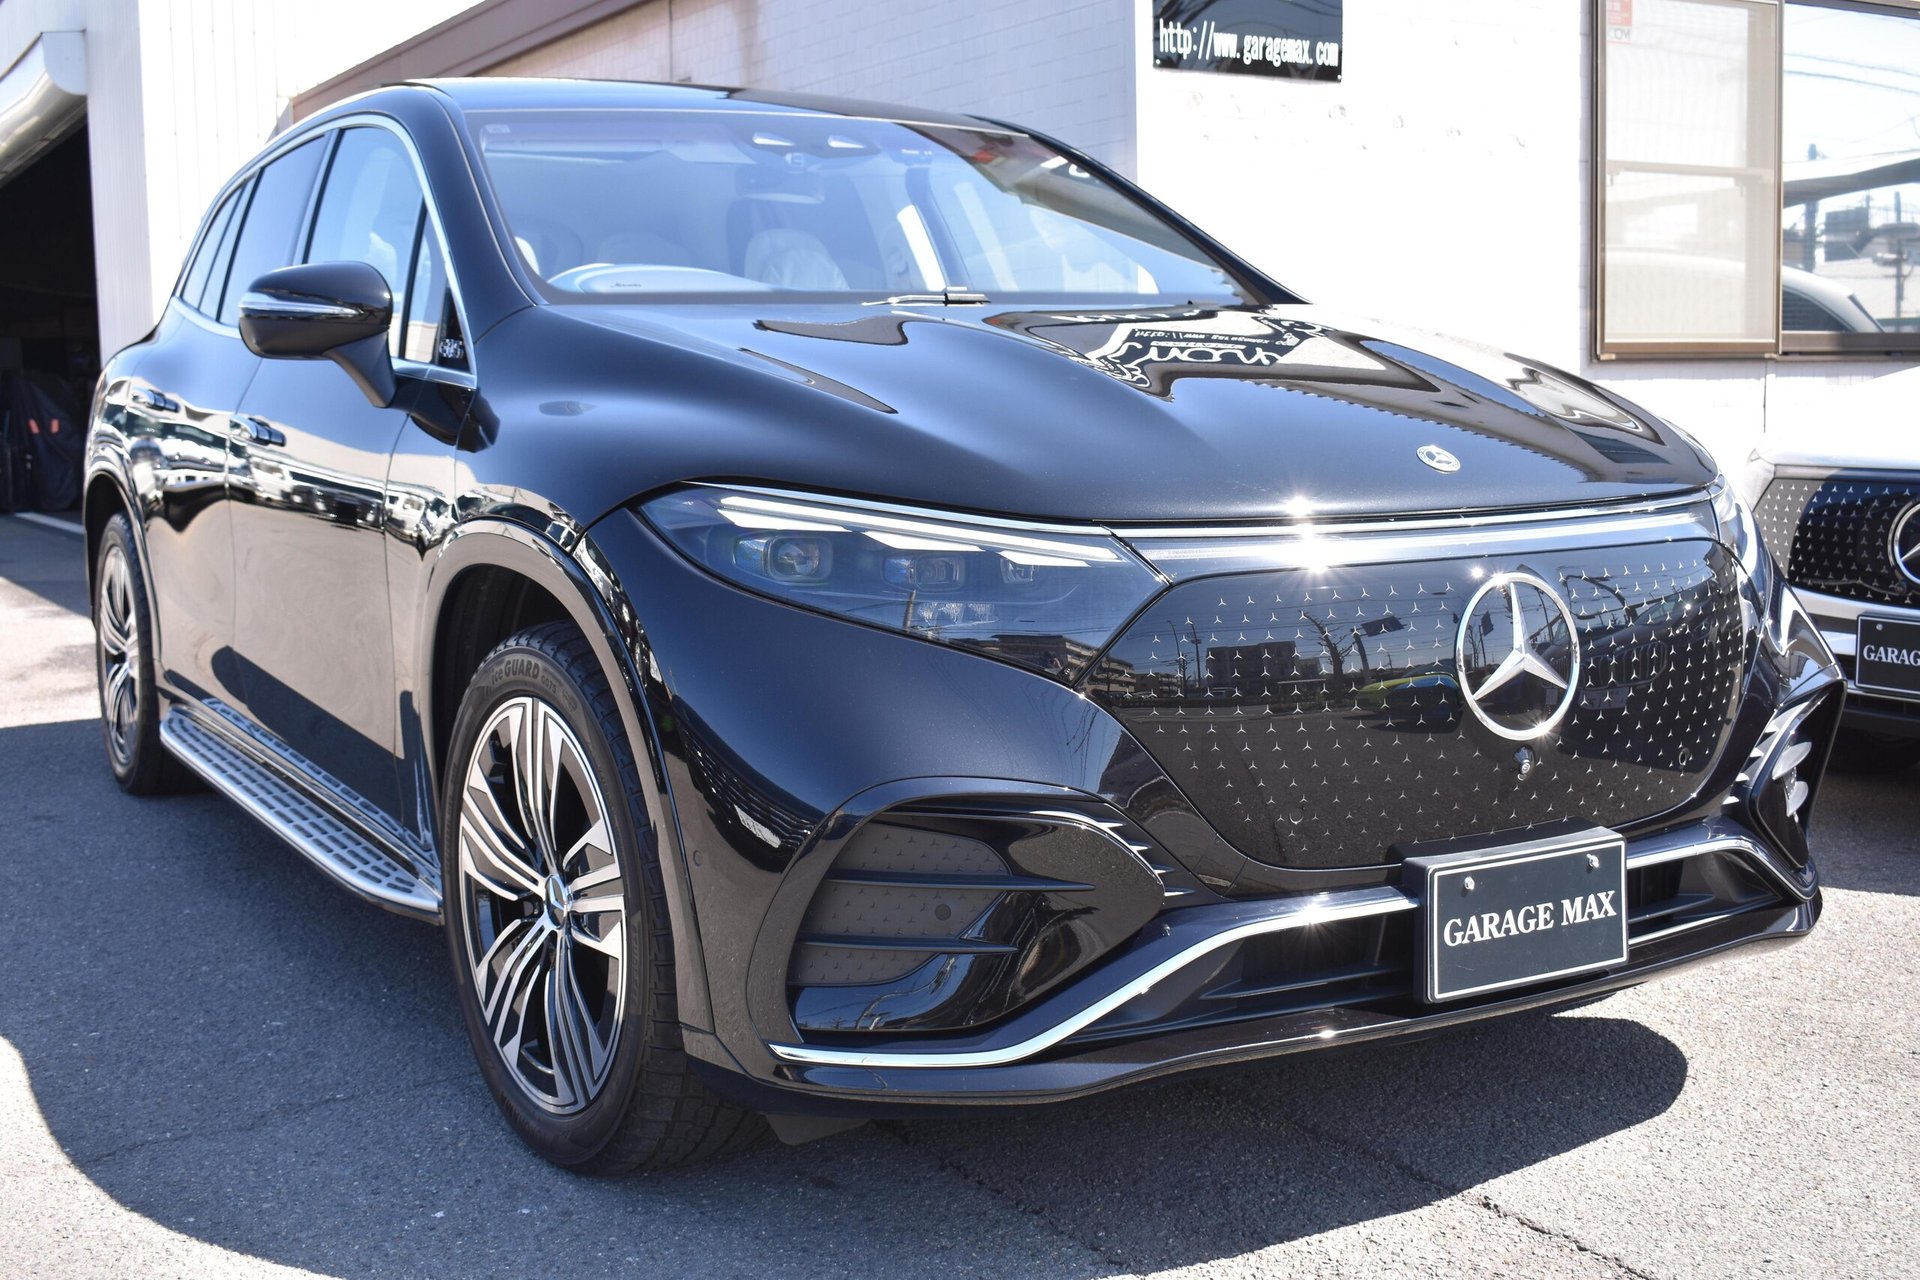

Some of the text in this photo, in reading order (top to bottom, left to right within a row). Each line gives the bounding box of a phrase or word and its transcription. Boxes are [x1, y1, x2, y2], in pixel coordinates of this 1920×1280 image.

[1159, 18, 1339, 67] http://www.garagemax.com
[1443, 890, 1617, 947] GARAGE MAX
